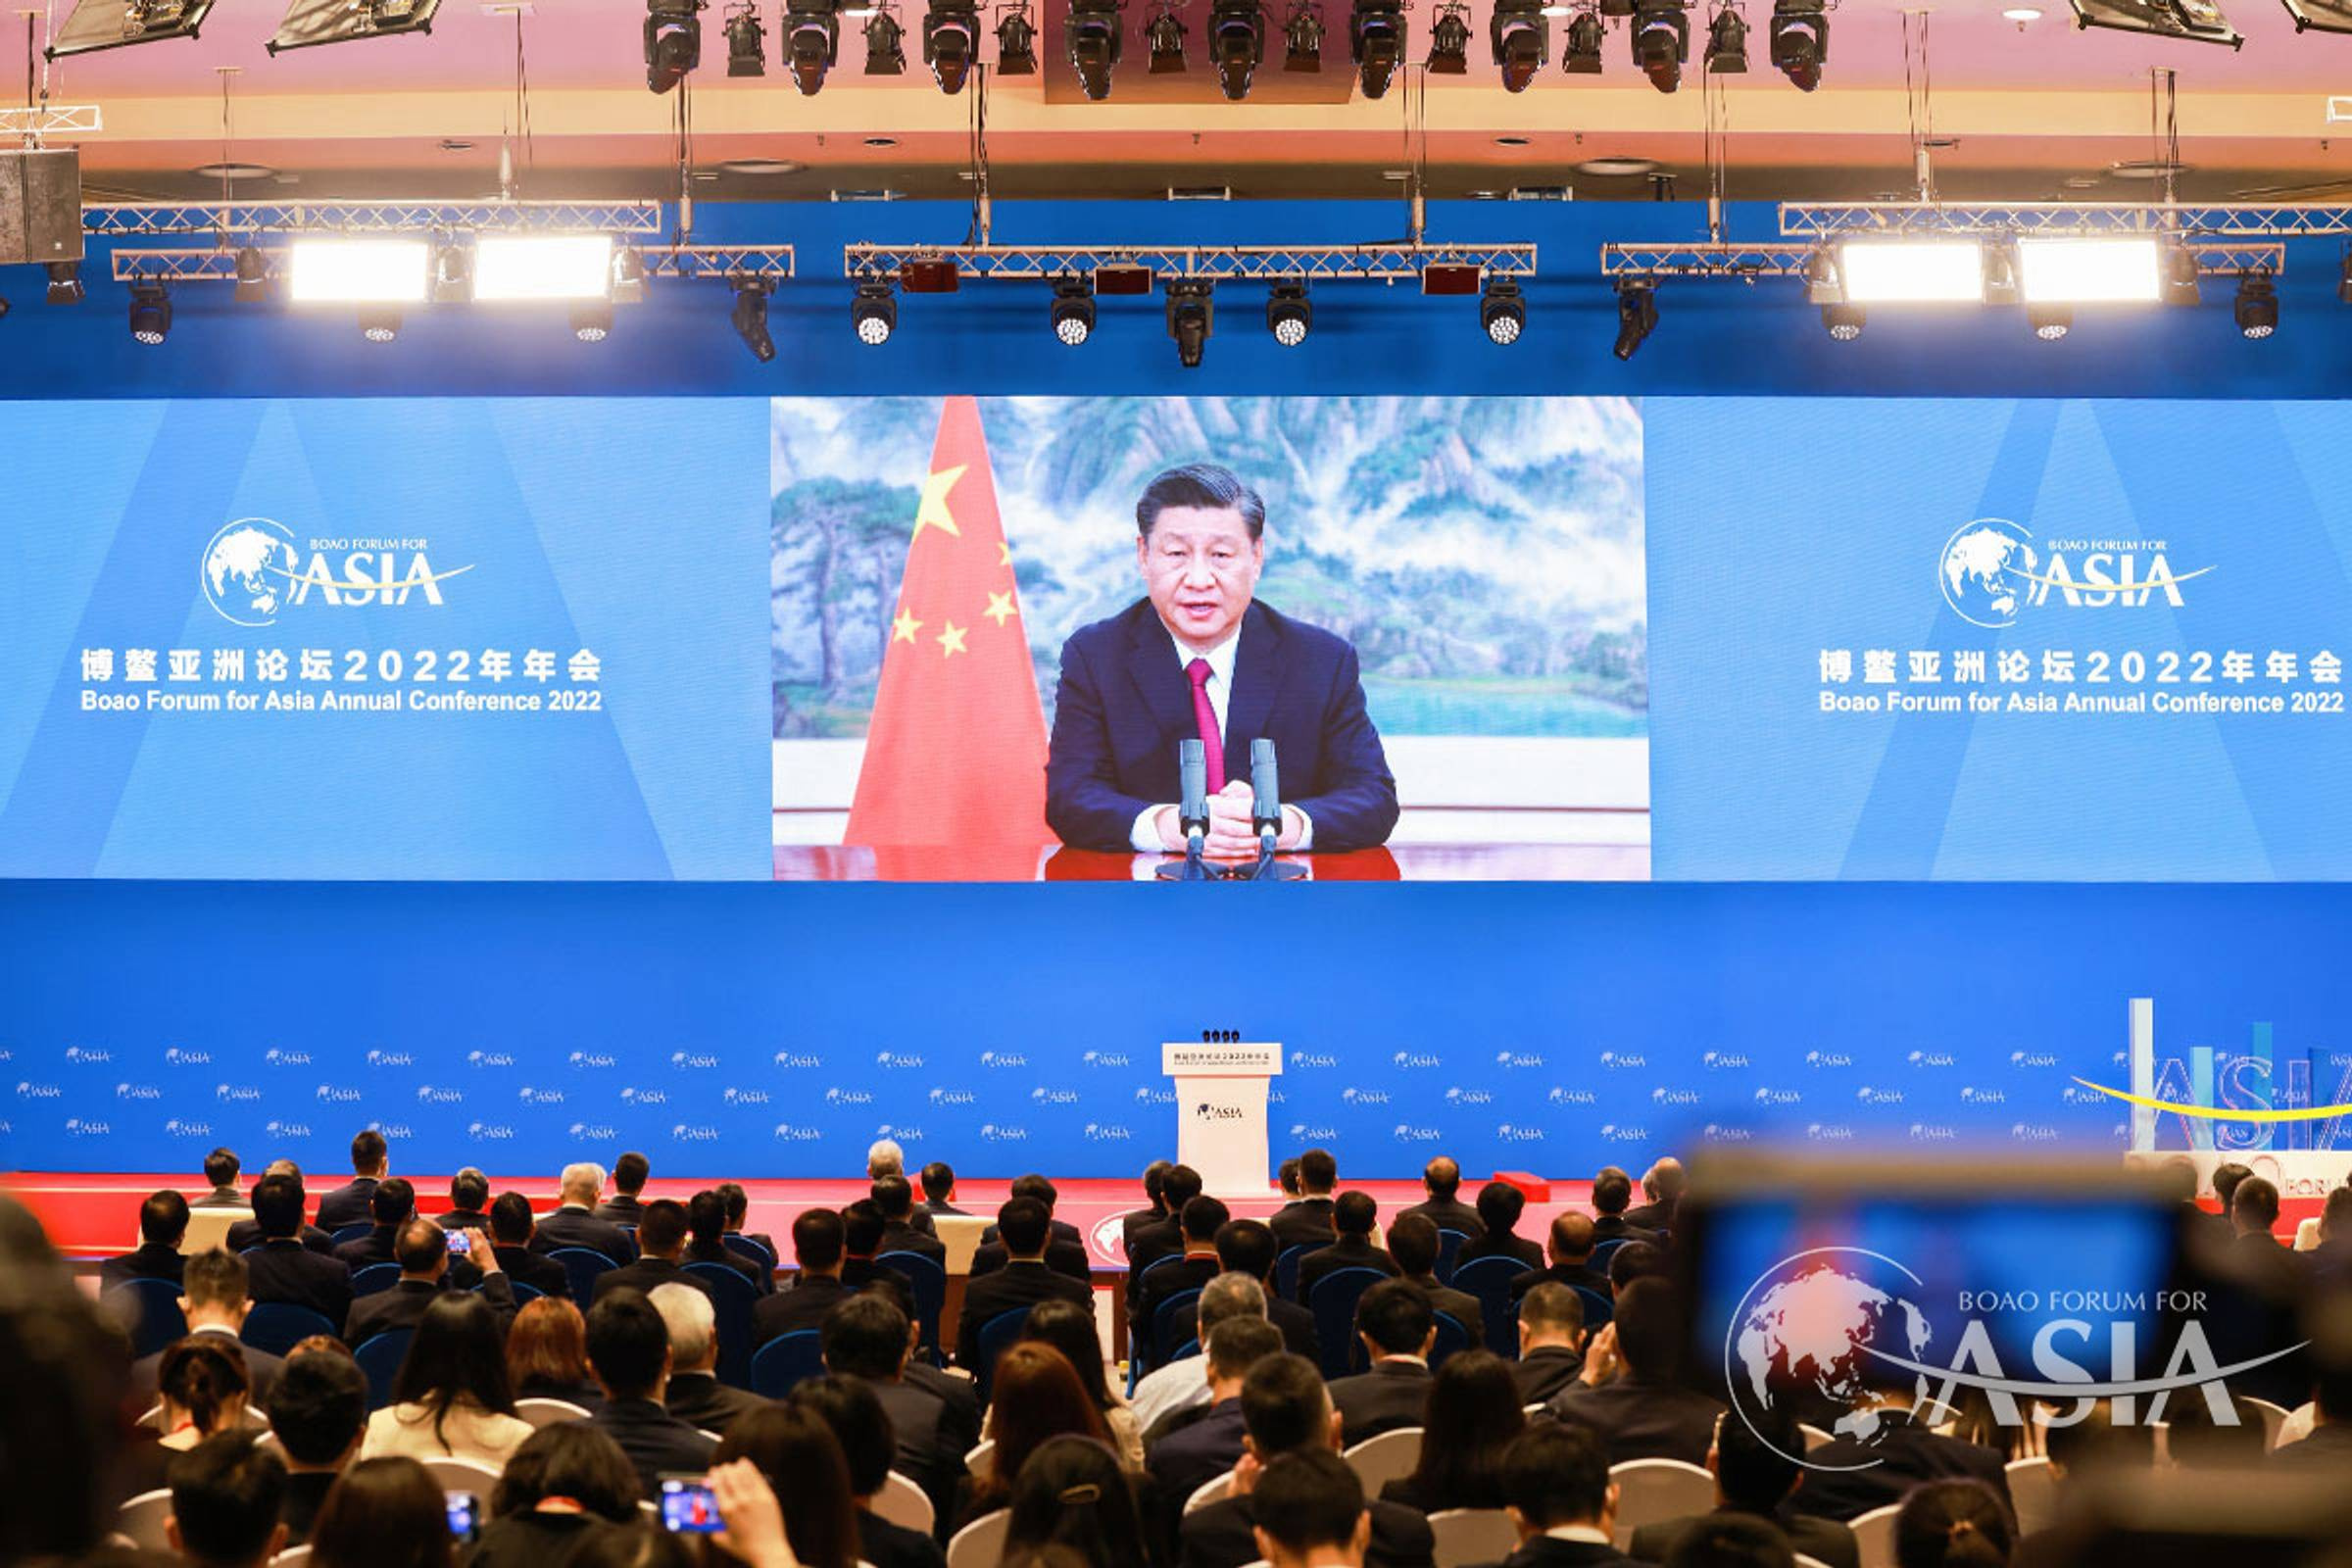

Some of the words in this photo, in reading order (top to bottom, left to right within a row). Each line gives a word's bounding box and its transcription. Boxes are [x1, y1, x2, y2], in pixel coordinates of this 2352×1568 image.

[310, 538, 348, 551] BOAO
[353, 538, 399, 551] FORUM
[403, 538, 427, 551] FOR
[2048, 540, 2087, 551] BOAO
[2090, 540, 2138, 551] FORUM
[2141, 540, 2167, 551] FOR
[295, 552, 444, 606] ASIA
[2035, 554, 2185, 608] ASIA
[80, 648, 602, 683] 博鳌亚洲论坛2022年年会
[1819, 650, 2342, 684] 博鳌亚洲论坛2022年年会
[81, 690, 140, 711] Boao
[147, 690, 220, 711] Forum
[226, 690, 259, 711] for
[265, 690, 315, 711] Asia
[320, 690, 402, 711] Annual
[409, 690, 541, 711] Conference
[548, 690, 603, 711] 2022
[1819, 691, 1880, 713] Boao
[1887, 691, 1961, 713] Forum
[1968, 691, 2001, 713] for
[2006, 691, 2057, 713] Asia
[2064, 691, 2145, 713] Annual
[2152, 691, 2284, 713] Conference
[2291, 691, 2344, 713] 2022
[1214, 1106, 1243, 1118] ASIA
